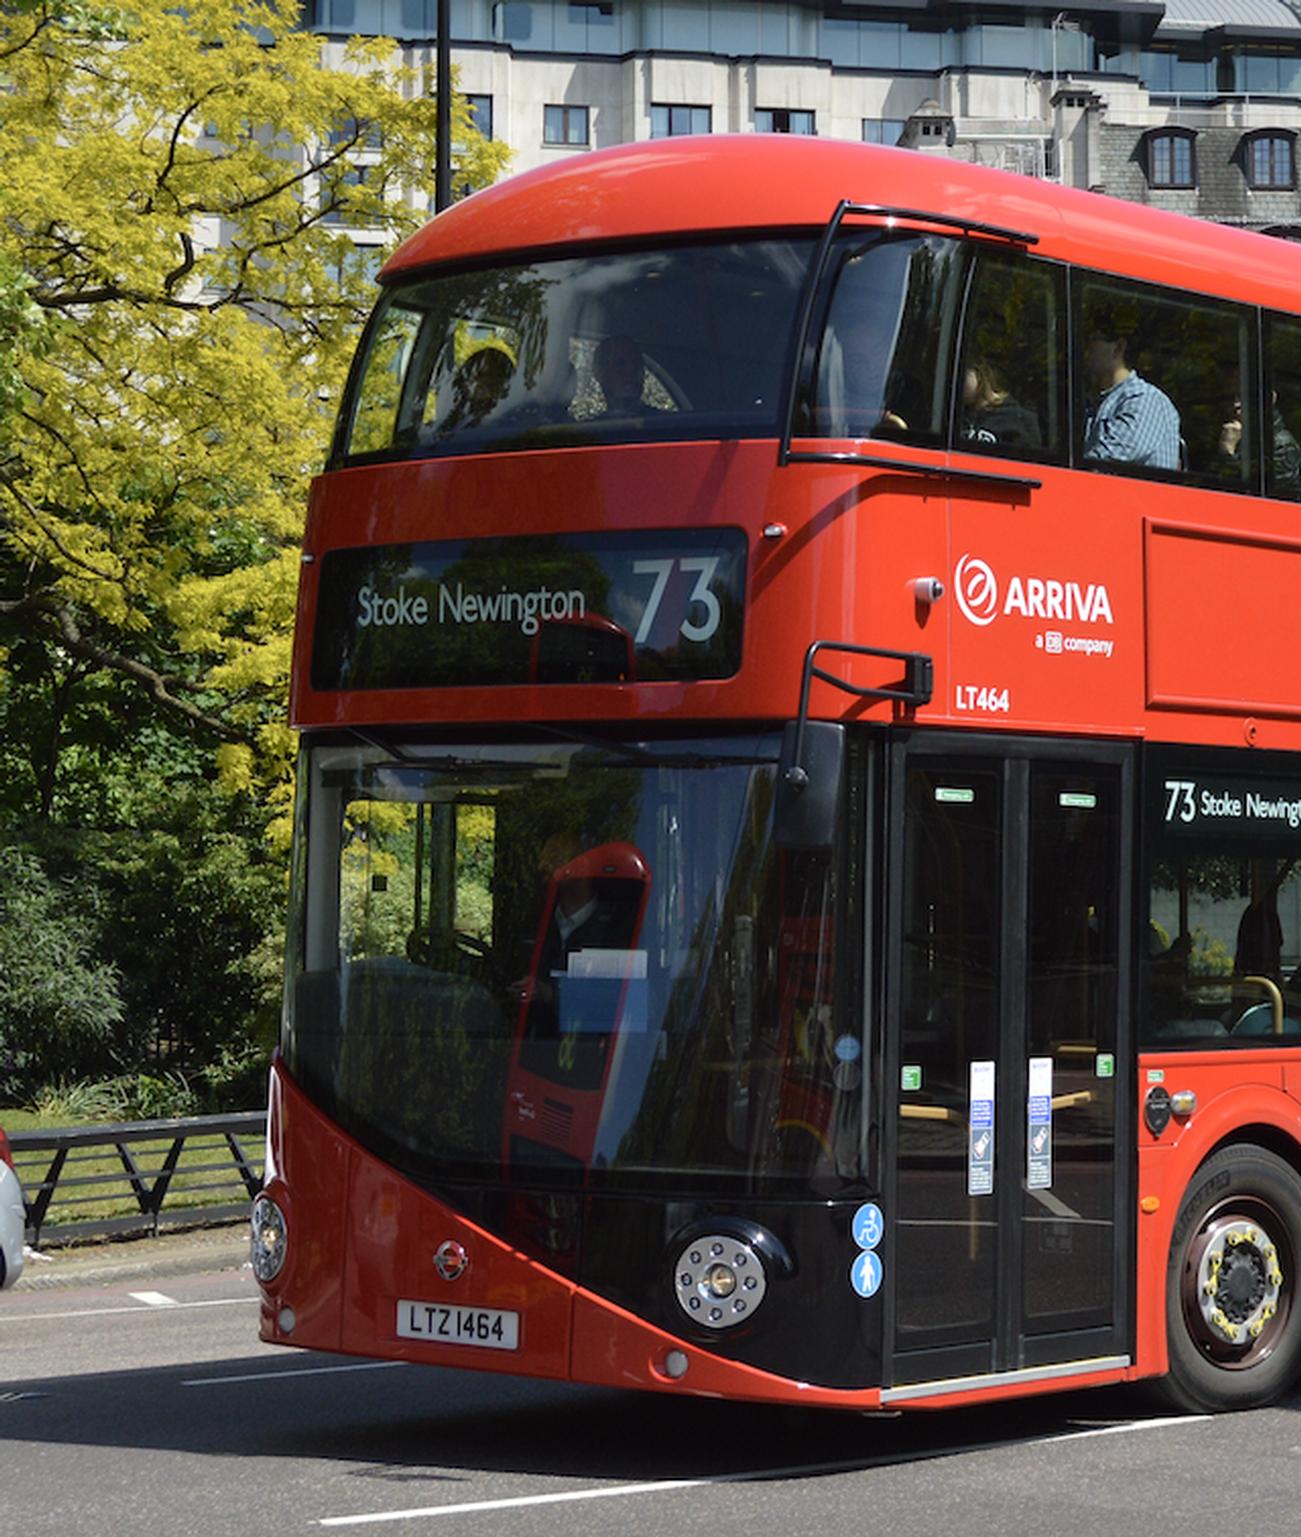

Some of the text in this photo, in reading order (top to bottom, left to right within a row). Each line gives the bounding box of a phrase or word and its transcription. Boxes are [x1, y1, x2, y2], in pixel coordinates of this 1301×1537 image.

[357, 582, 585, 635] Stoke Newington
[633, 556, 721, 644] 73
[1003, 576, 1114, 624] ARRIVA
[1035, 634, 1044, 648] a
[1064, 637, 1114, 658] company
[956, 685, 1010, 713] LT464
[1165, 780, 1196, 823] 73
[1201, 789, 1242, 817] Stoke
[410, 1305, 503, 1342] LTZ 1464
